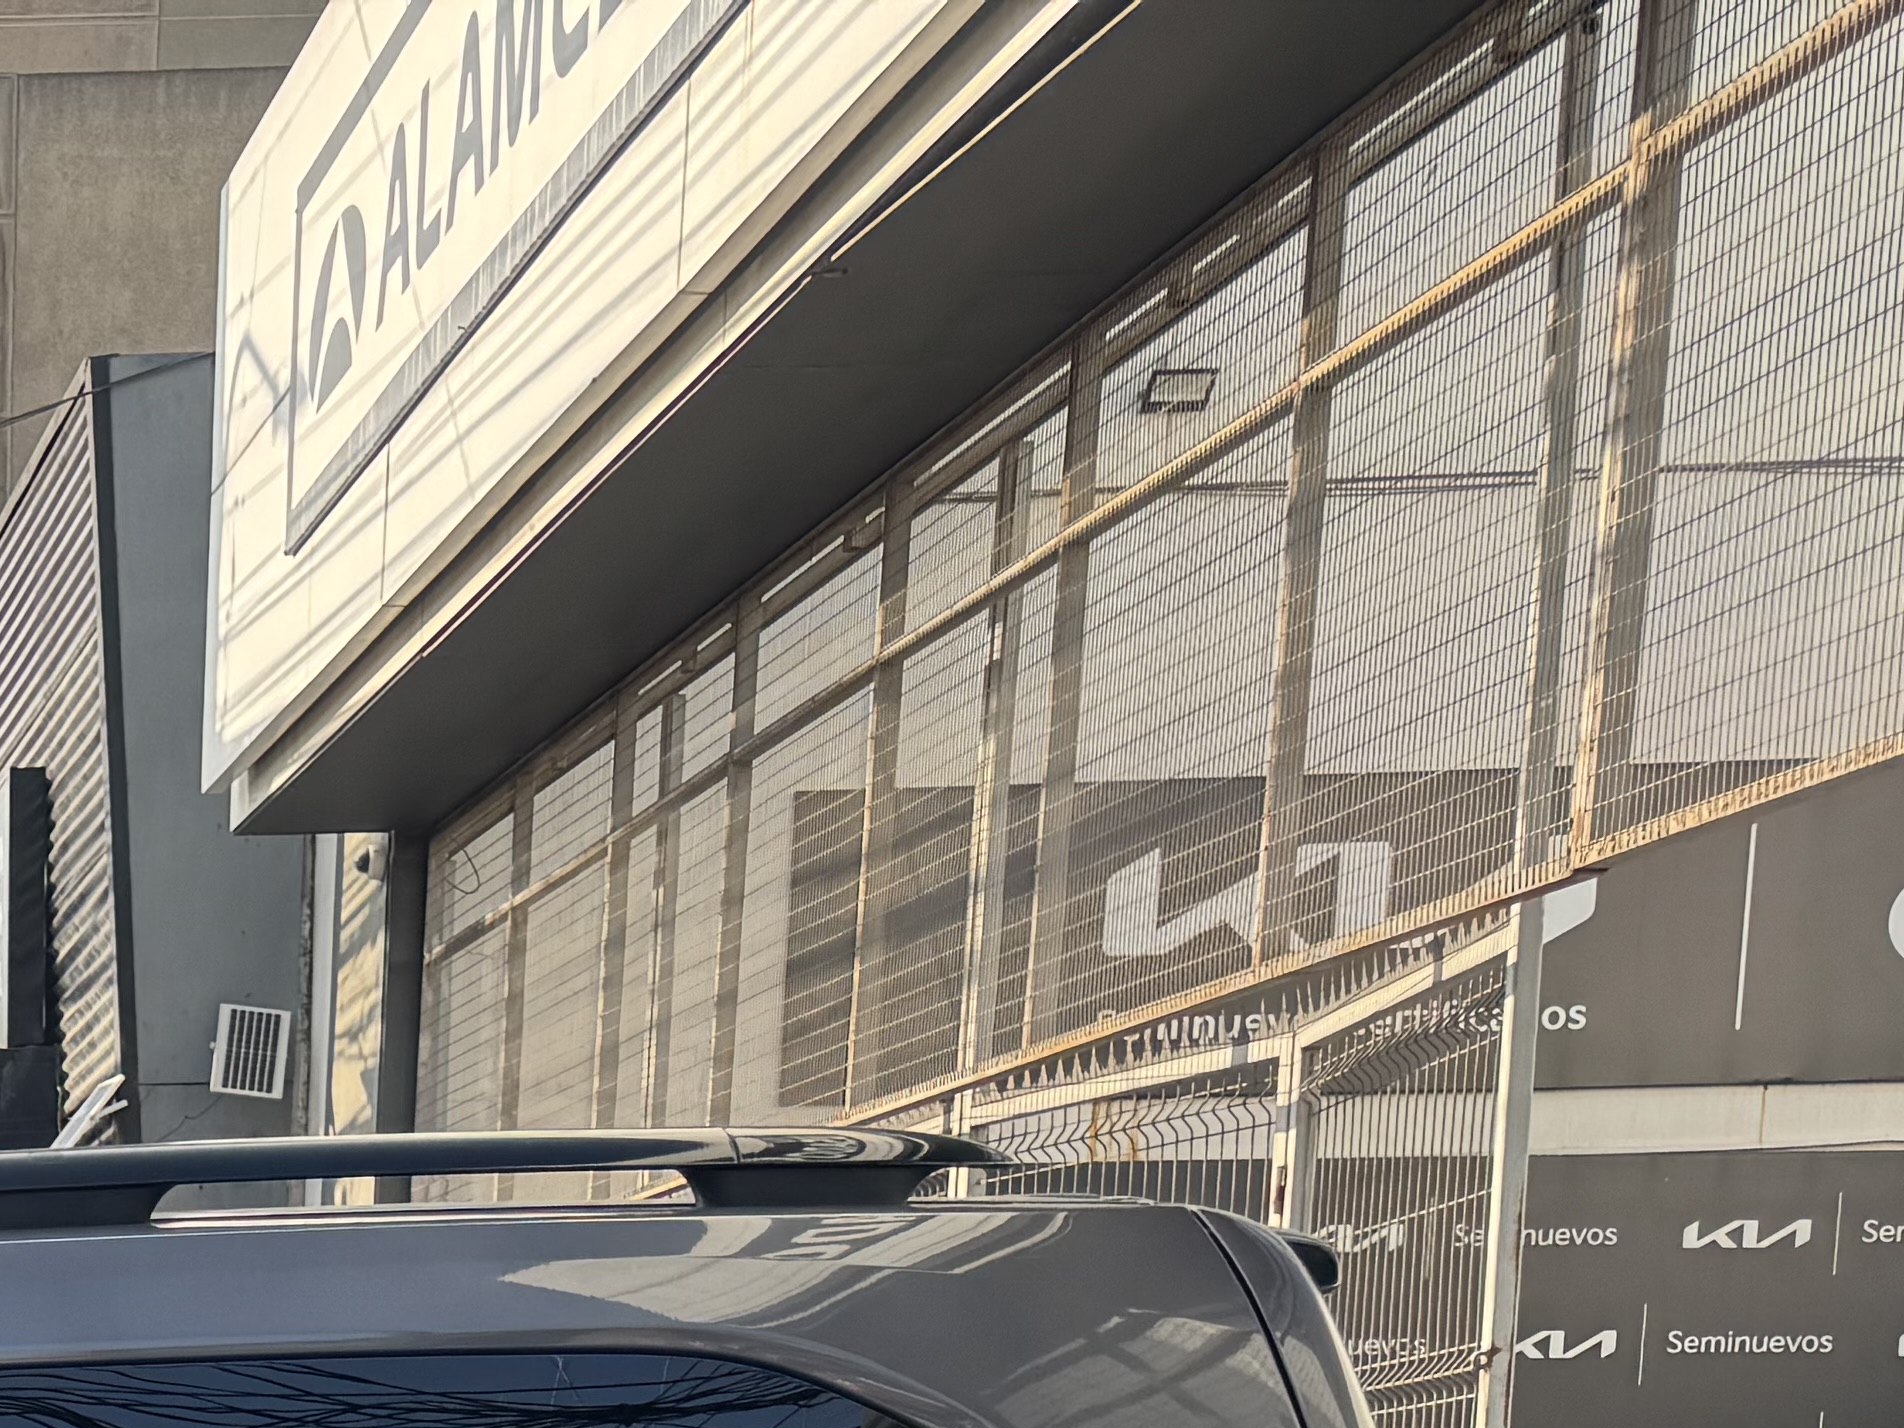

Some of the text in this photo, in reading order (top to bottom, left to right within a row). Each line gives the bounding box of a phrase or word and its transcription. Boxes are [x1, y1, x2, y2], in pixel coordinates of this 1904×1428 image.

[375, 0, 623, 333] ALAM
[1453, 1224, 1619, 1248] Senuevos
[1682, 1218, 1813, 1249] KIA
[1666, 1330, 1834, 1354] Seminuevos
